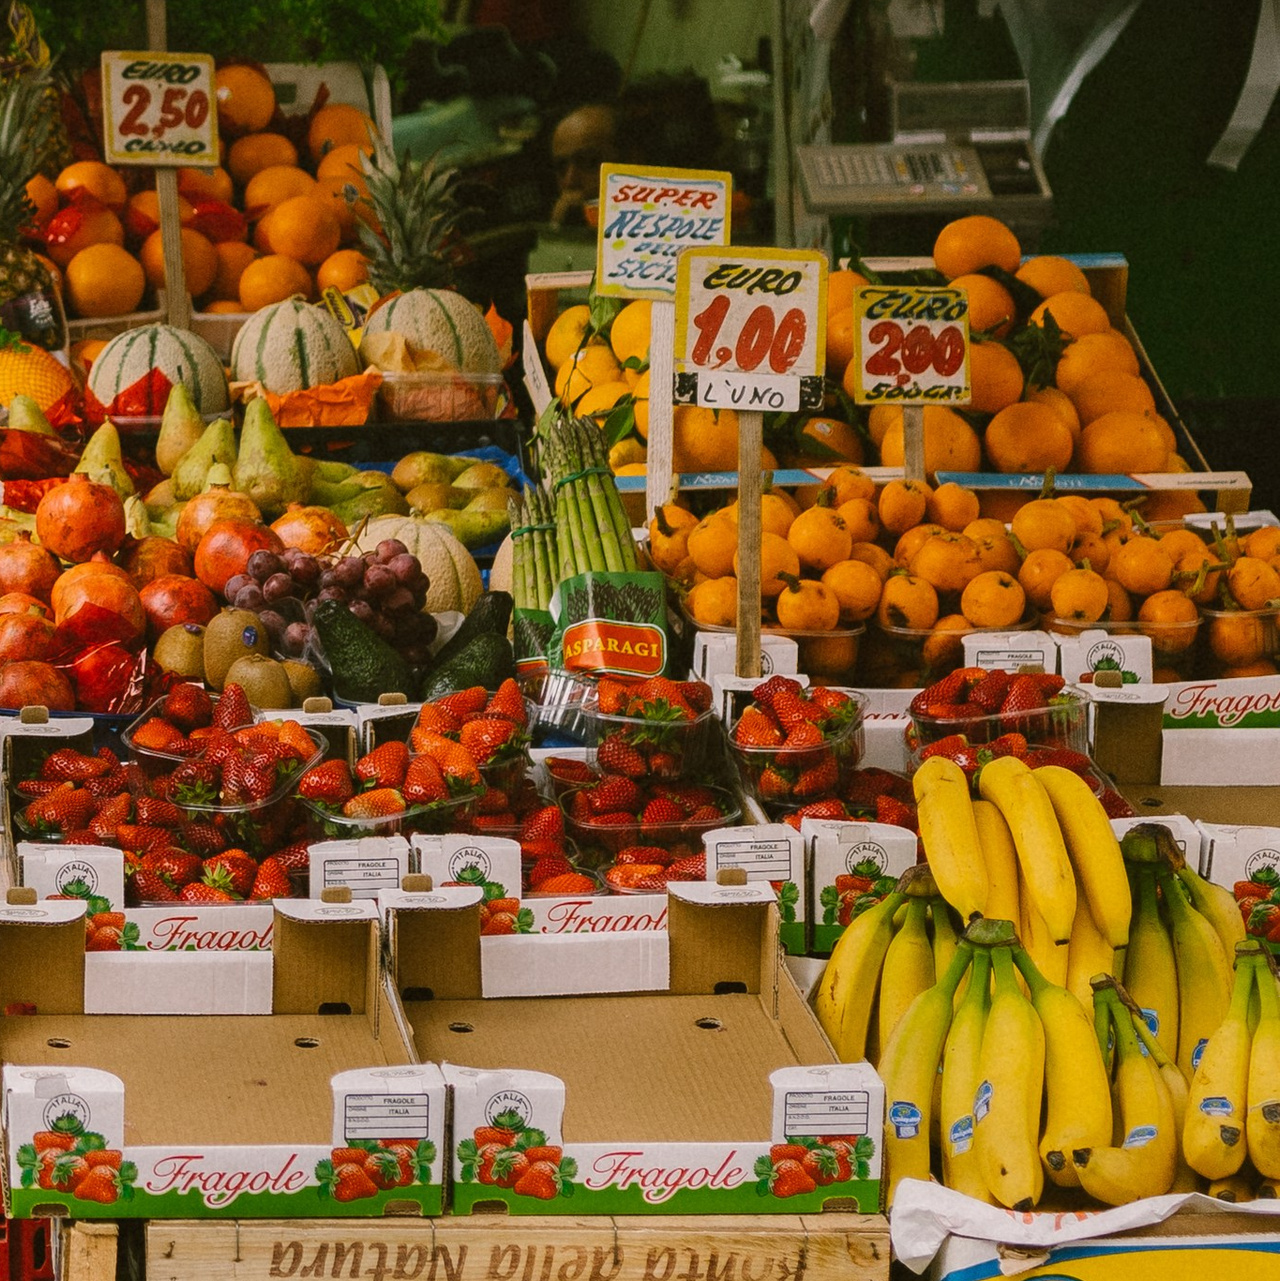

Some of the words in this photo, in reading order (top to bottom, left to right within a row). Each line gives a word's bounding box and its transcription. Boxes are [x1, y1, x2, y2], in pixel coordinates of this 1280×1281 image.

[122, 61, 202, 84] EURO
[119, 84, 210, 139] 2,50
[612, 183, 718, 210] SUPER
[604, 209, 724, 239] NESPOLE
[703, 263, 803, 296] EURO
[865, 290, 968, 321] EURO
[691, 294, 808, 374] 1,00
[565, 636, 660, 661] ASPARAGI
[455, 850, 484, 861] ITALIA
[853, 844, 881, 856] ITALIA
[62, 862, 91, 876] ITALIA
[50, 1094, 83, 1110] ITALIA
[491, 1091, 527, 1108] ITALIA
[145, 1153, 314, 1209] Fragole
[583, 1150, 753, 1206] Fragole
